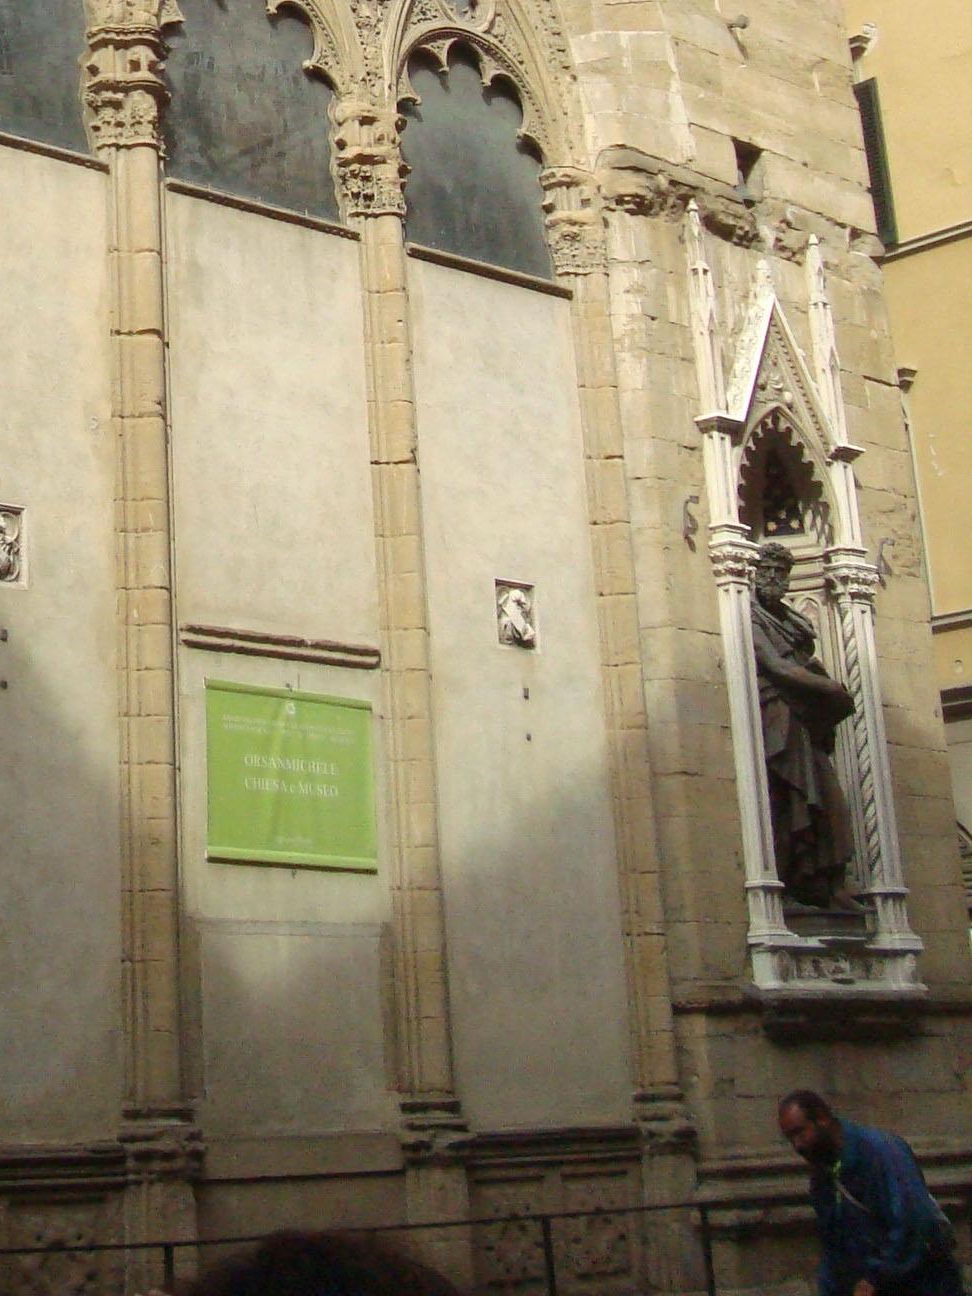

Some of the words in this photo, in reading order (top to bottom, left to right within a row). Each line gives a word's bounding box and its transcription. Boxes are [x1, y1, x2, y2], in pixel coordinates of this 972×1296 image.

[244, 754, 338, 775] ORSANMICHELE
[244, 777, 288, 794] CHIESA
[298, 781, 339, 798] MUSEO
